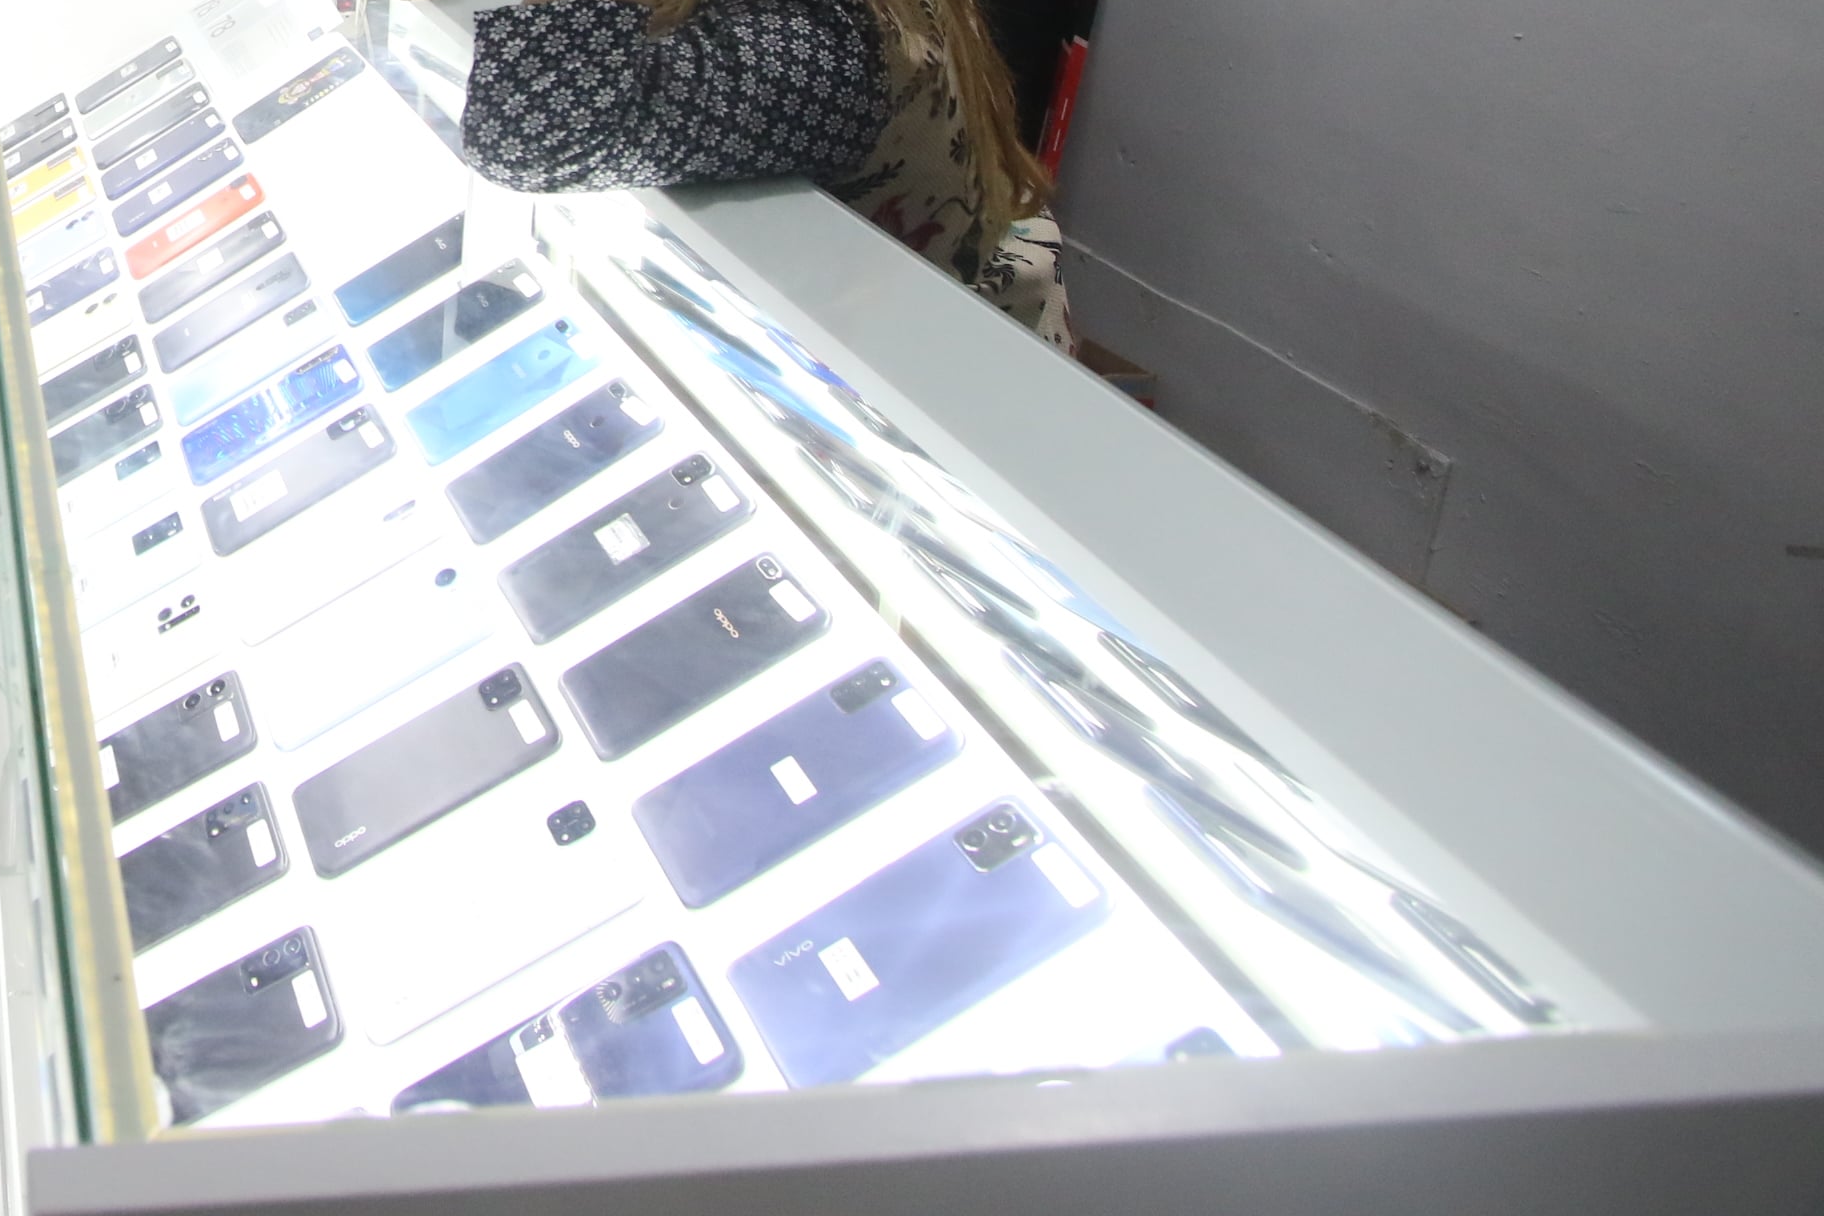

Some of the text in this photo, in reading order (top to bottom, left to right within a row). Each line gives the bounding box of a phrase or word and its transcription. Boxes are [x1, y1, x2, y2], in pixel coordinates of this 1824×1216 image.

[563, 429, 581, 449] oppo
[713, 607, 740, 639] oppo
[334, 825, 367, 848] oppo
[773, 939, 815, 967] vivo
